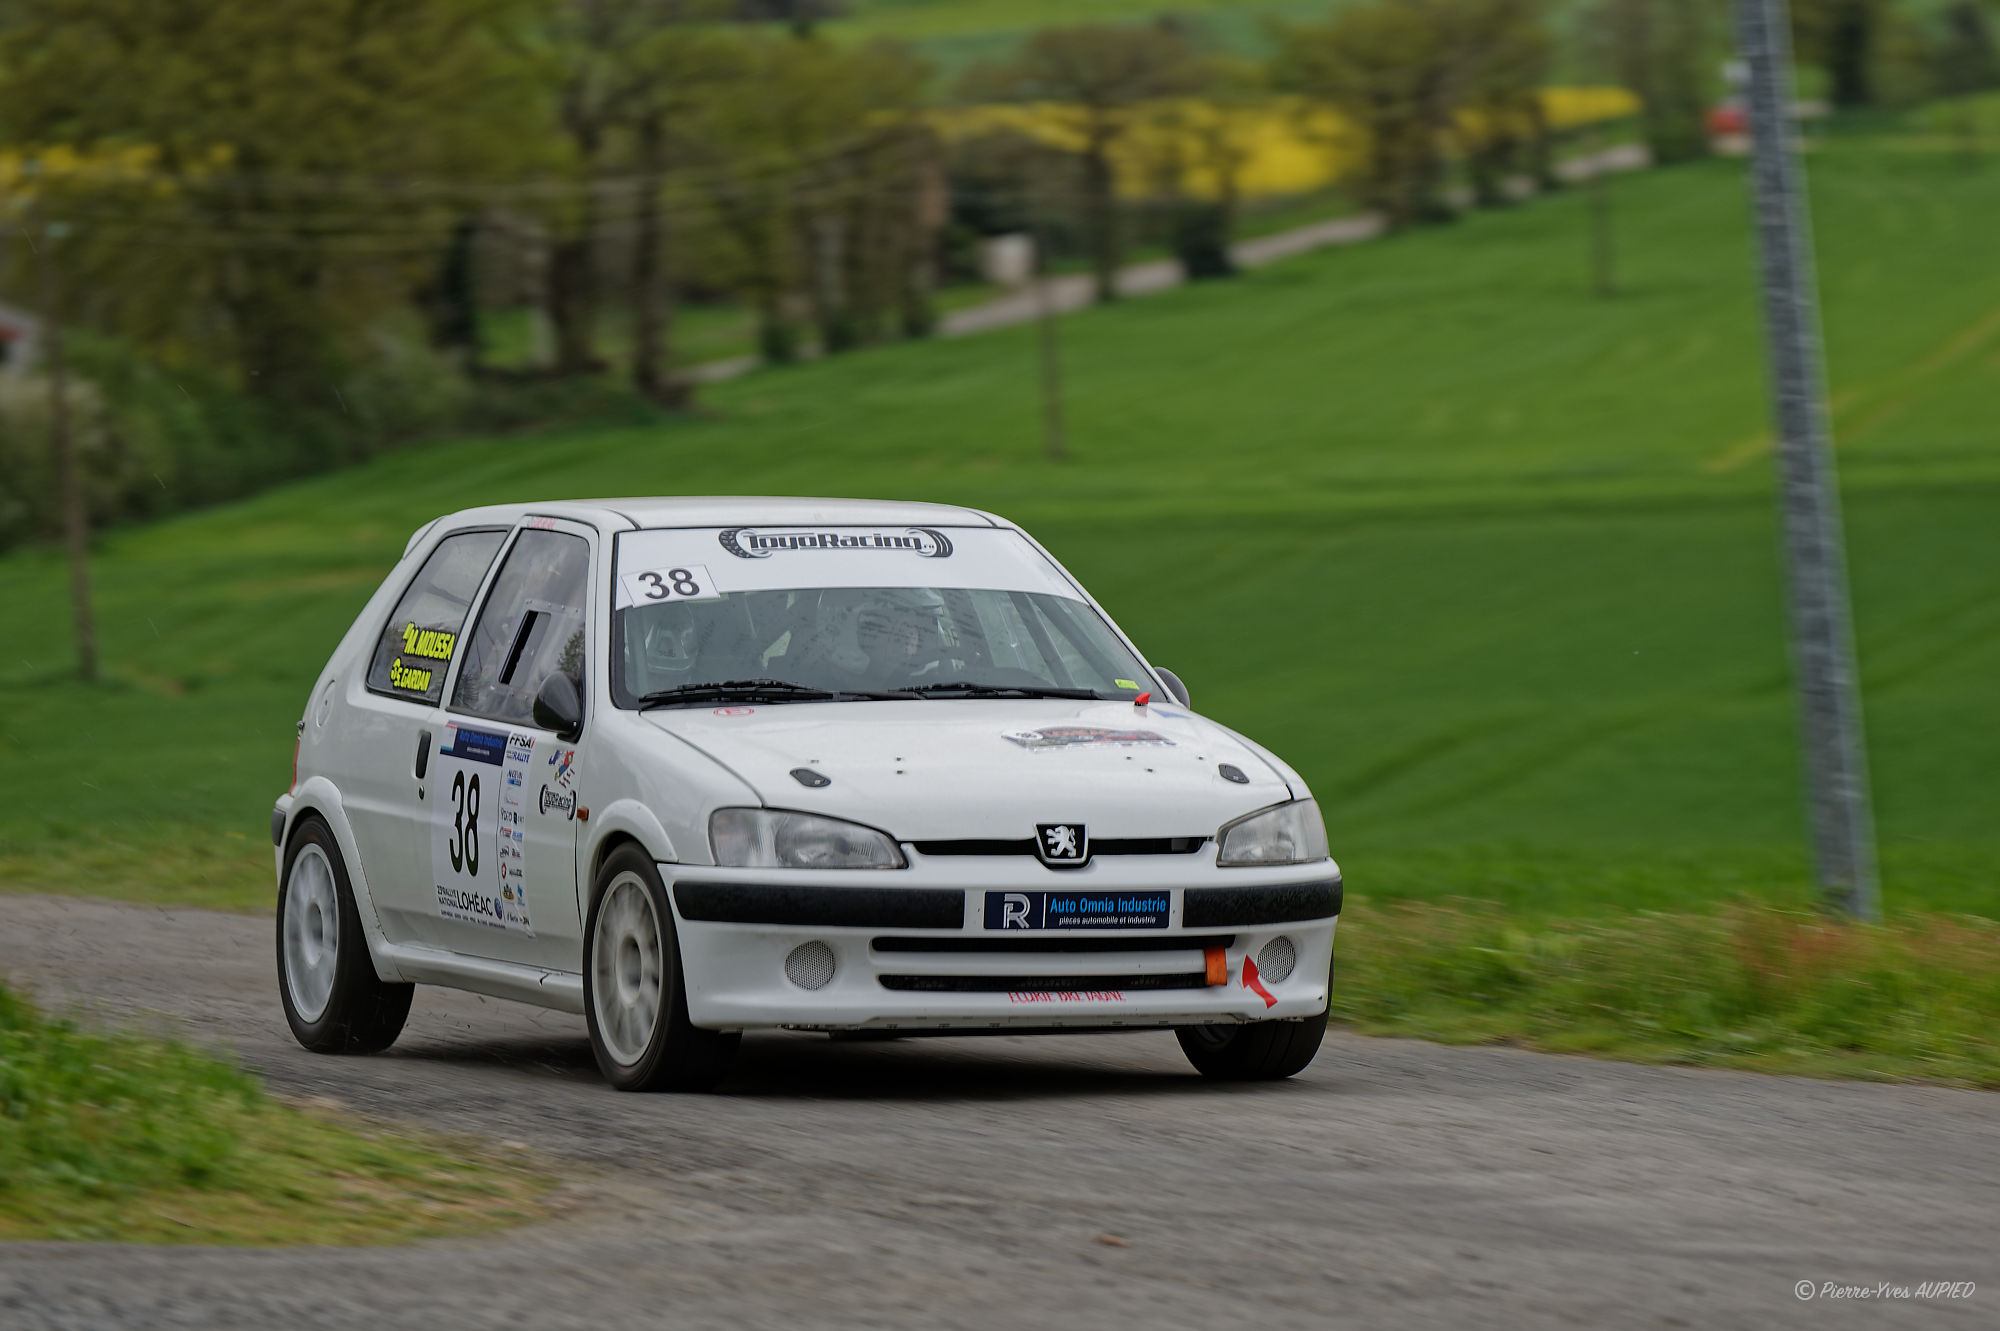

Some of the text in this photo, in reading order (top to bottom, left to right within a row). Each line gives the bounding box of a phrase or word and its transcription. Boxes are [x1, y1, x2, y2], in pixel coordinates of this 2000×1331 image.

[638, 568, 700, 600] 38
[414, 630, 456, 661] MOUSSA
[449, 769, 481, 877] 38
[456, 889, 494, 917] LOHÉAC
[1050, 896, 1167, 913] Auto Omnia Industrie
[1081, 914, 1119, 925] automobile
